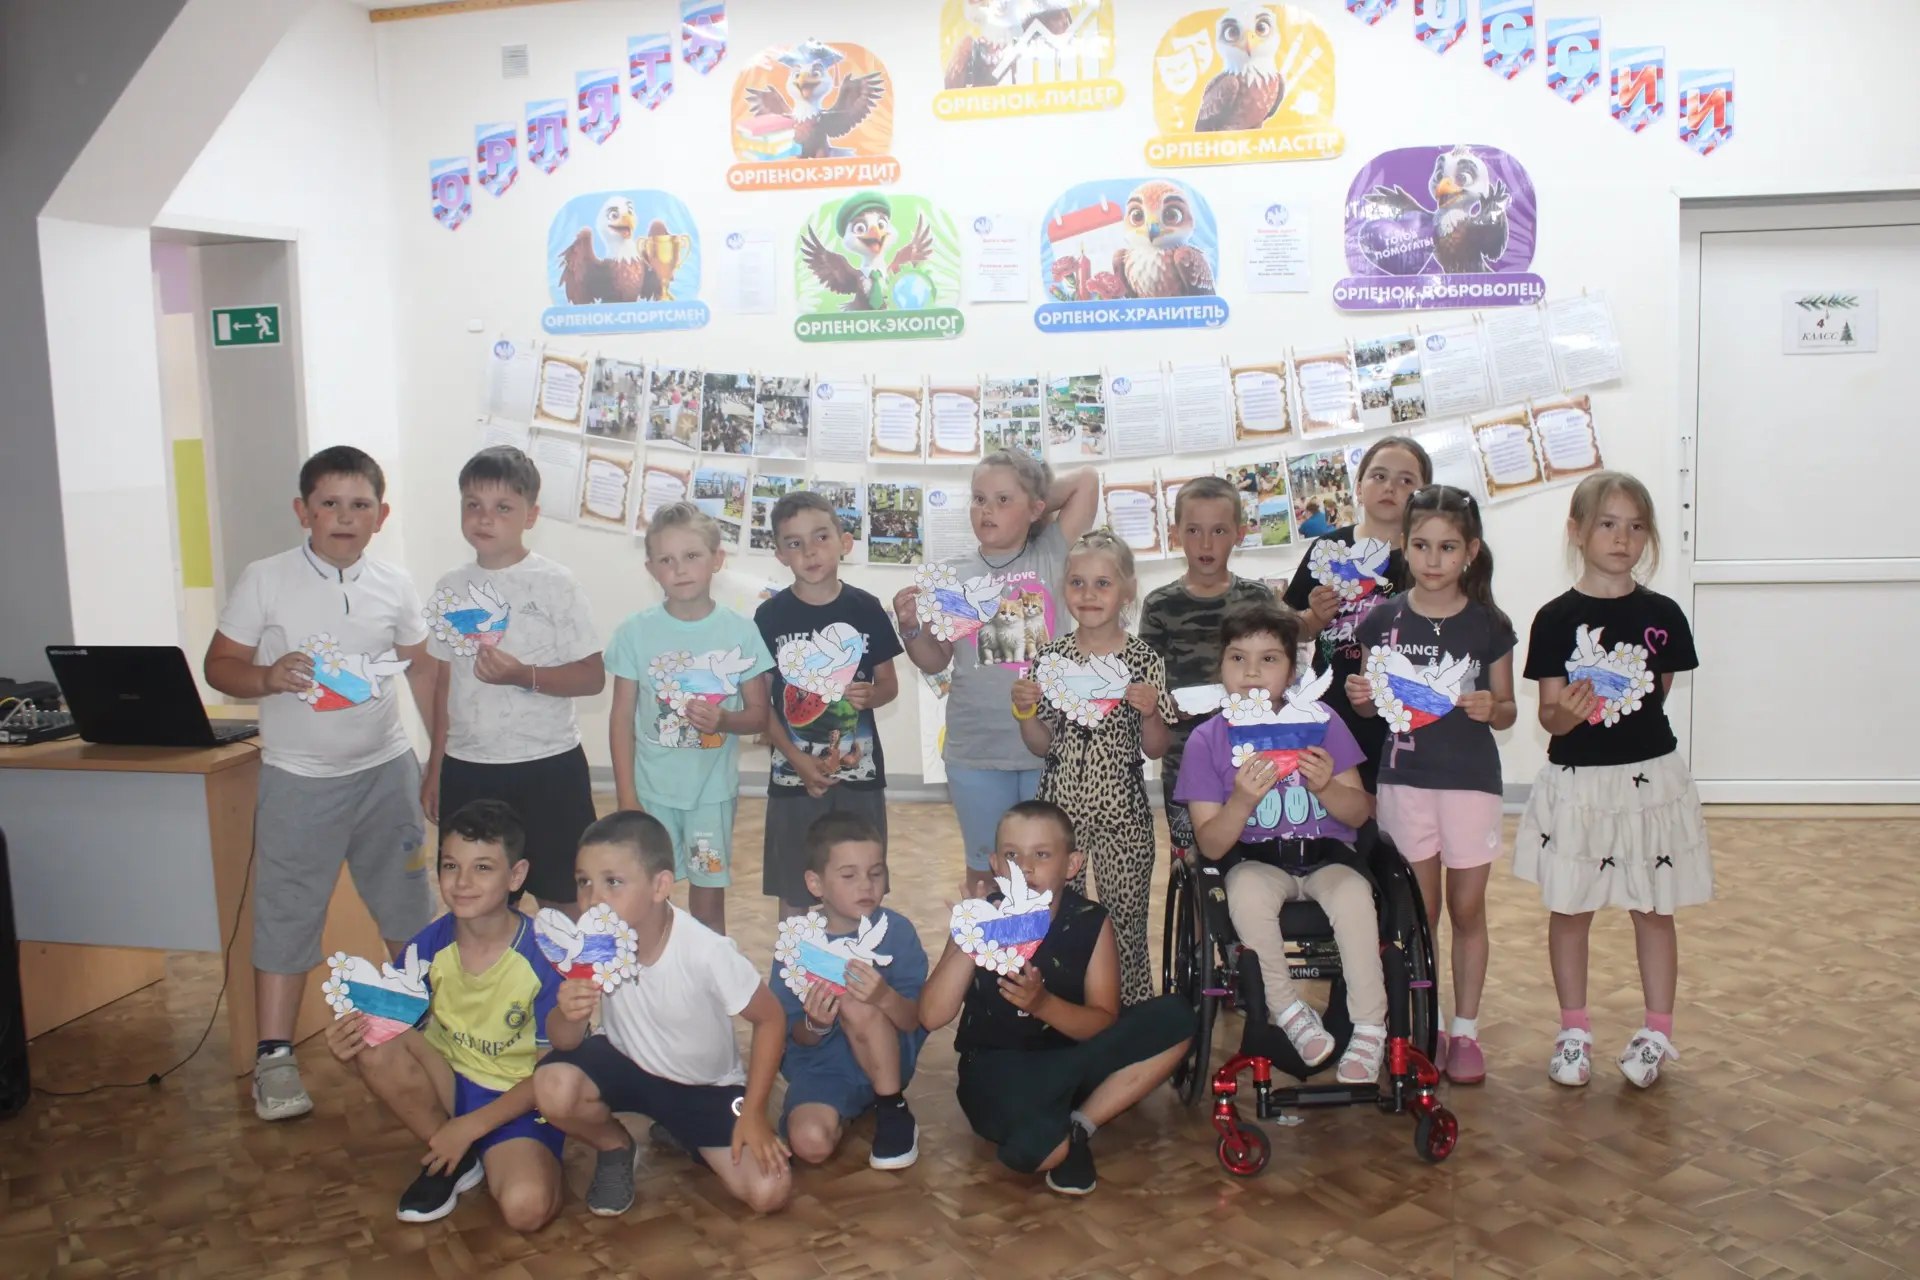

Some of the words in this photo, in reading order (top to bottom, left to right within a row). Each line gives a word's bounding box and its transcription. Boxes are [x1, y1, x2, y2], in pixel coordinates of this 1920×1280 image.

[1148, 133, 1340, 161] ОРЛЕНОК-МАСТЕР
[729, 162, 897, 186] ОРЛЕНОК-ЭРУДИТ
[544, 307, 706, 328] ОРЛЕНОК-СПОРТСМЕН
[797, 314, 960, 337] ОРЛЕНОК-ЭКОЛОГ
[1037, 304, 1225, 327] ОРЛЕНОК-ХРАНИТЕЛЬ
[1816, 318, 1825, 329] 4
[1801, 331, 1839, 341] КЛАСС
[1395, 643, 1439, 657] DANCE
[1289, 967, 1320, 978] KING
